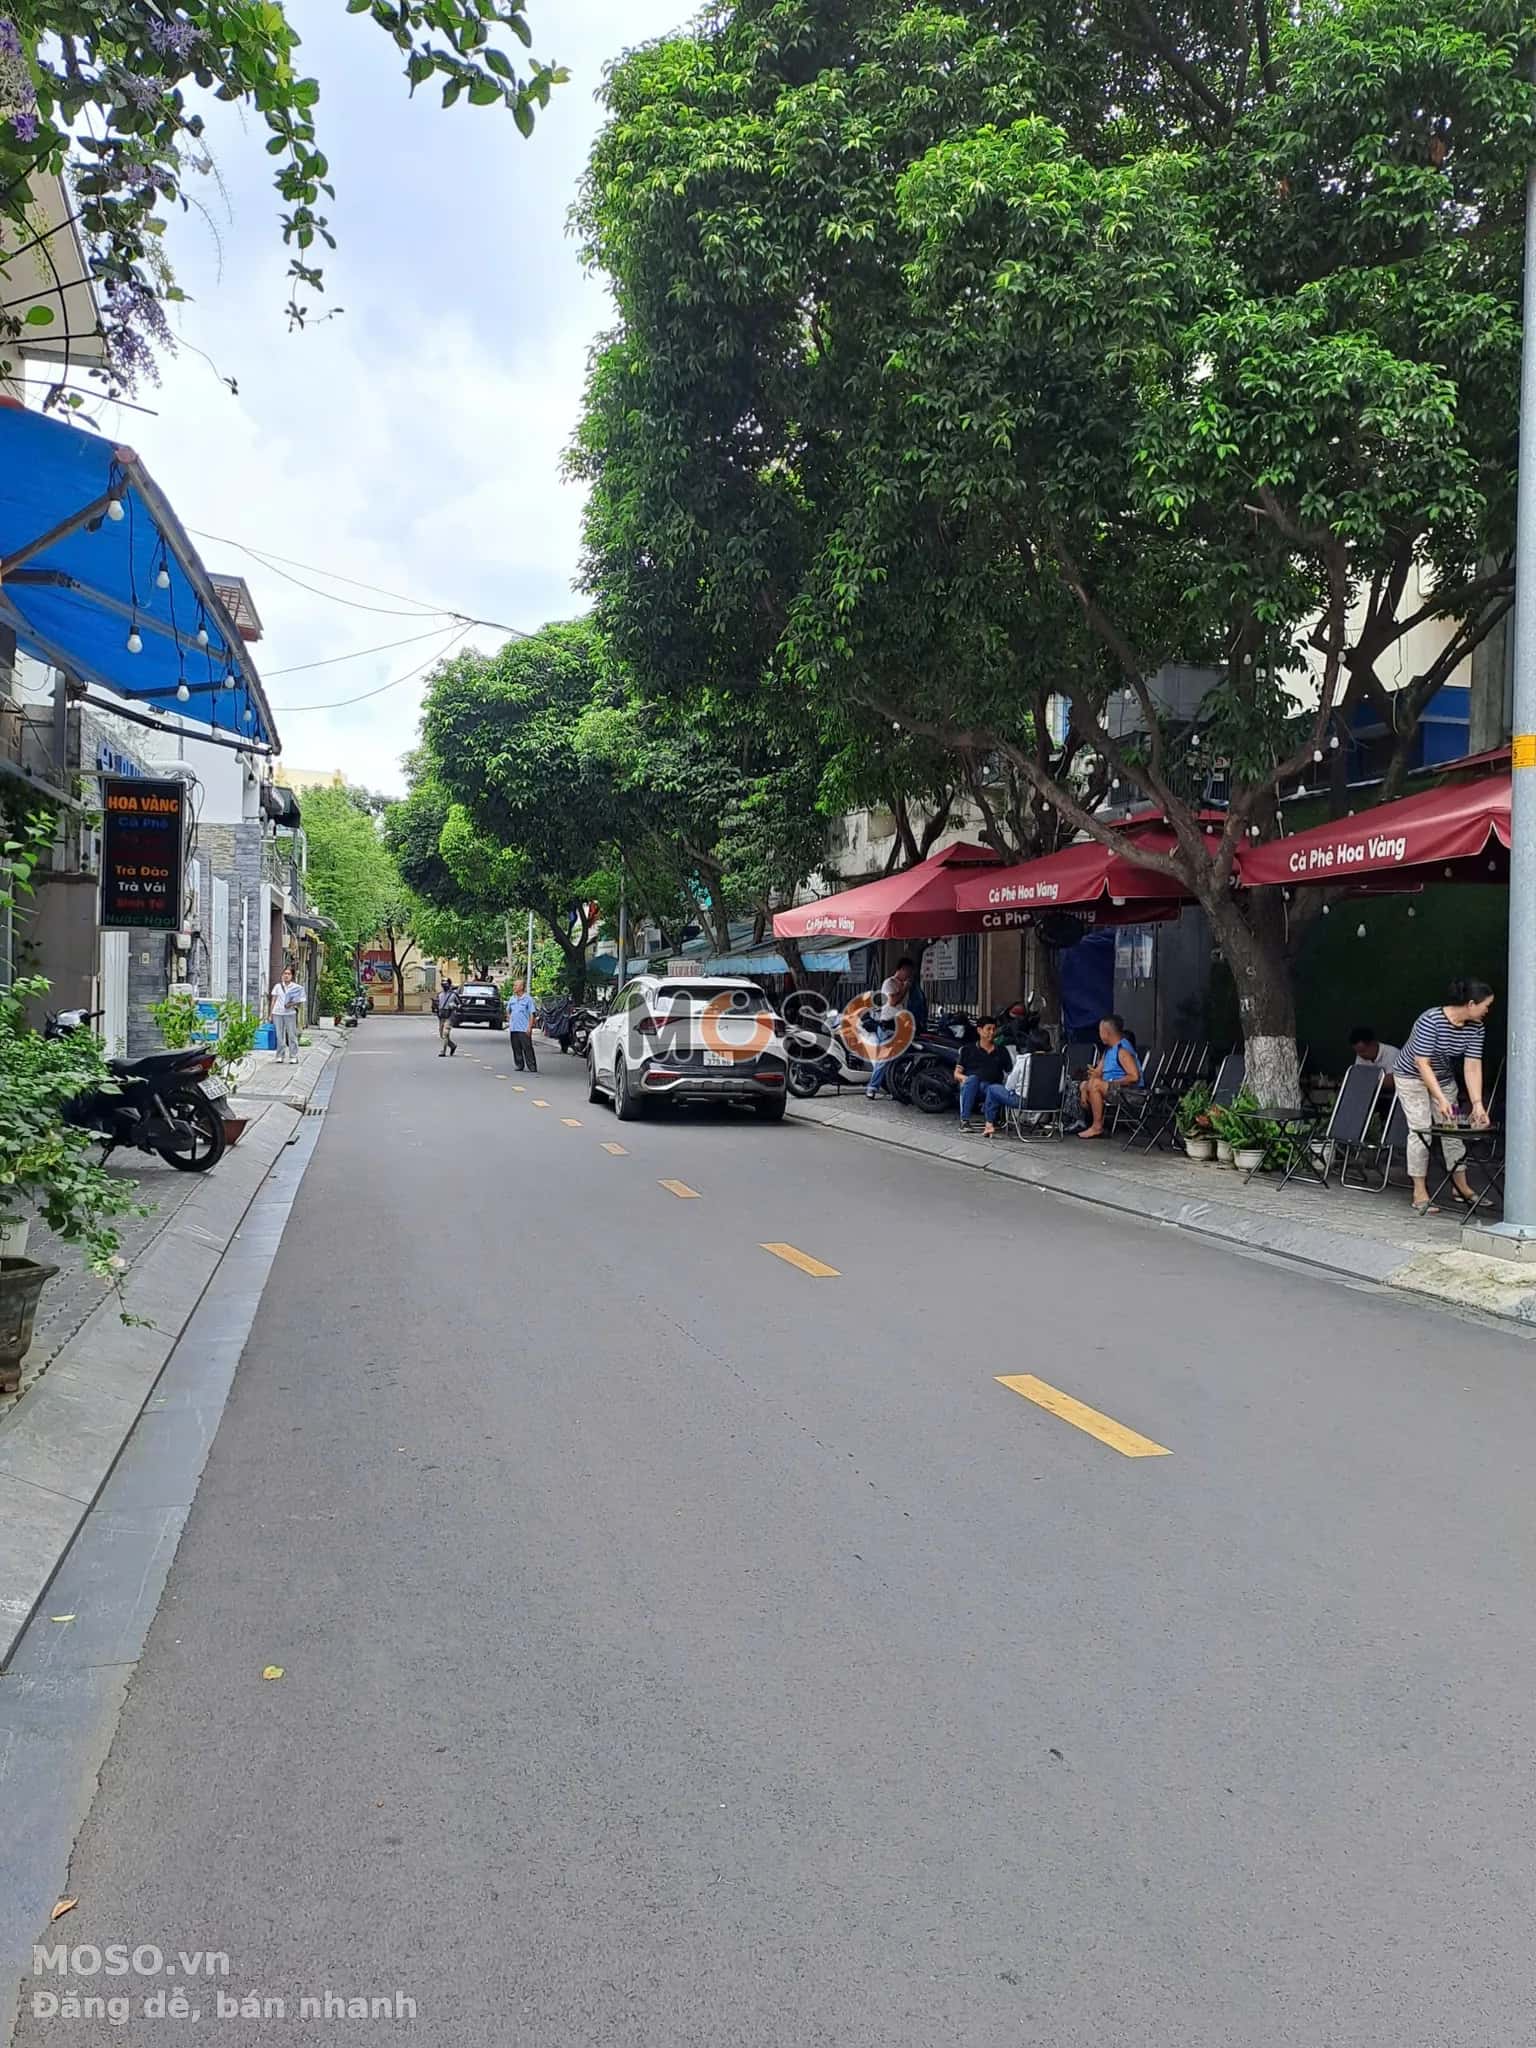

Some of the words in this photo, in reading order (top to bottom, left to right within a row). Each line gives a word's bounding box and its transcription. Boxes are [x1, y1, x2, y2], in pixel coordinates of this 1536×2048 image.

[108, 796, 137, 810] HOA
[141, 794, 178, 812] VÀNG
[1289, 849, 1306, 872] Cà
[1310, 845, 1333, 869] Phê
[1337, 843, 1364, 865] Hoa
[1368, 835, 1406, 861] Vàng
[115, 865, 136, 876] Trà
[140, 865, 169, 877] Đào
[118, 881, 139, 892] Trà
[988, 887, 1000, 903] Cà
[1018, 884, 1034, 900] Hoa
[1036, 881, 1059, 900] Vàng
[982, 913, 1001, 927] Cà
